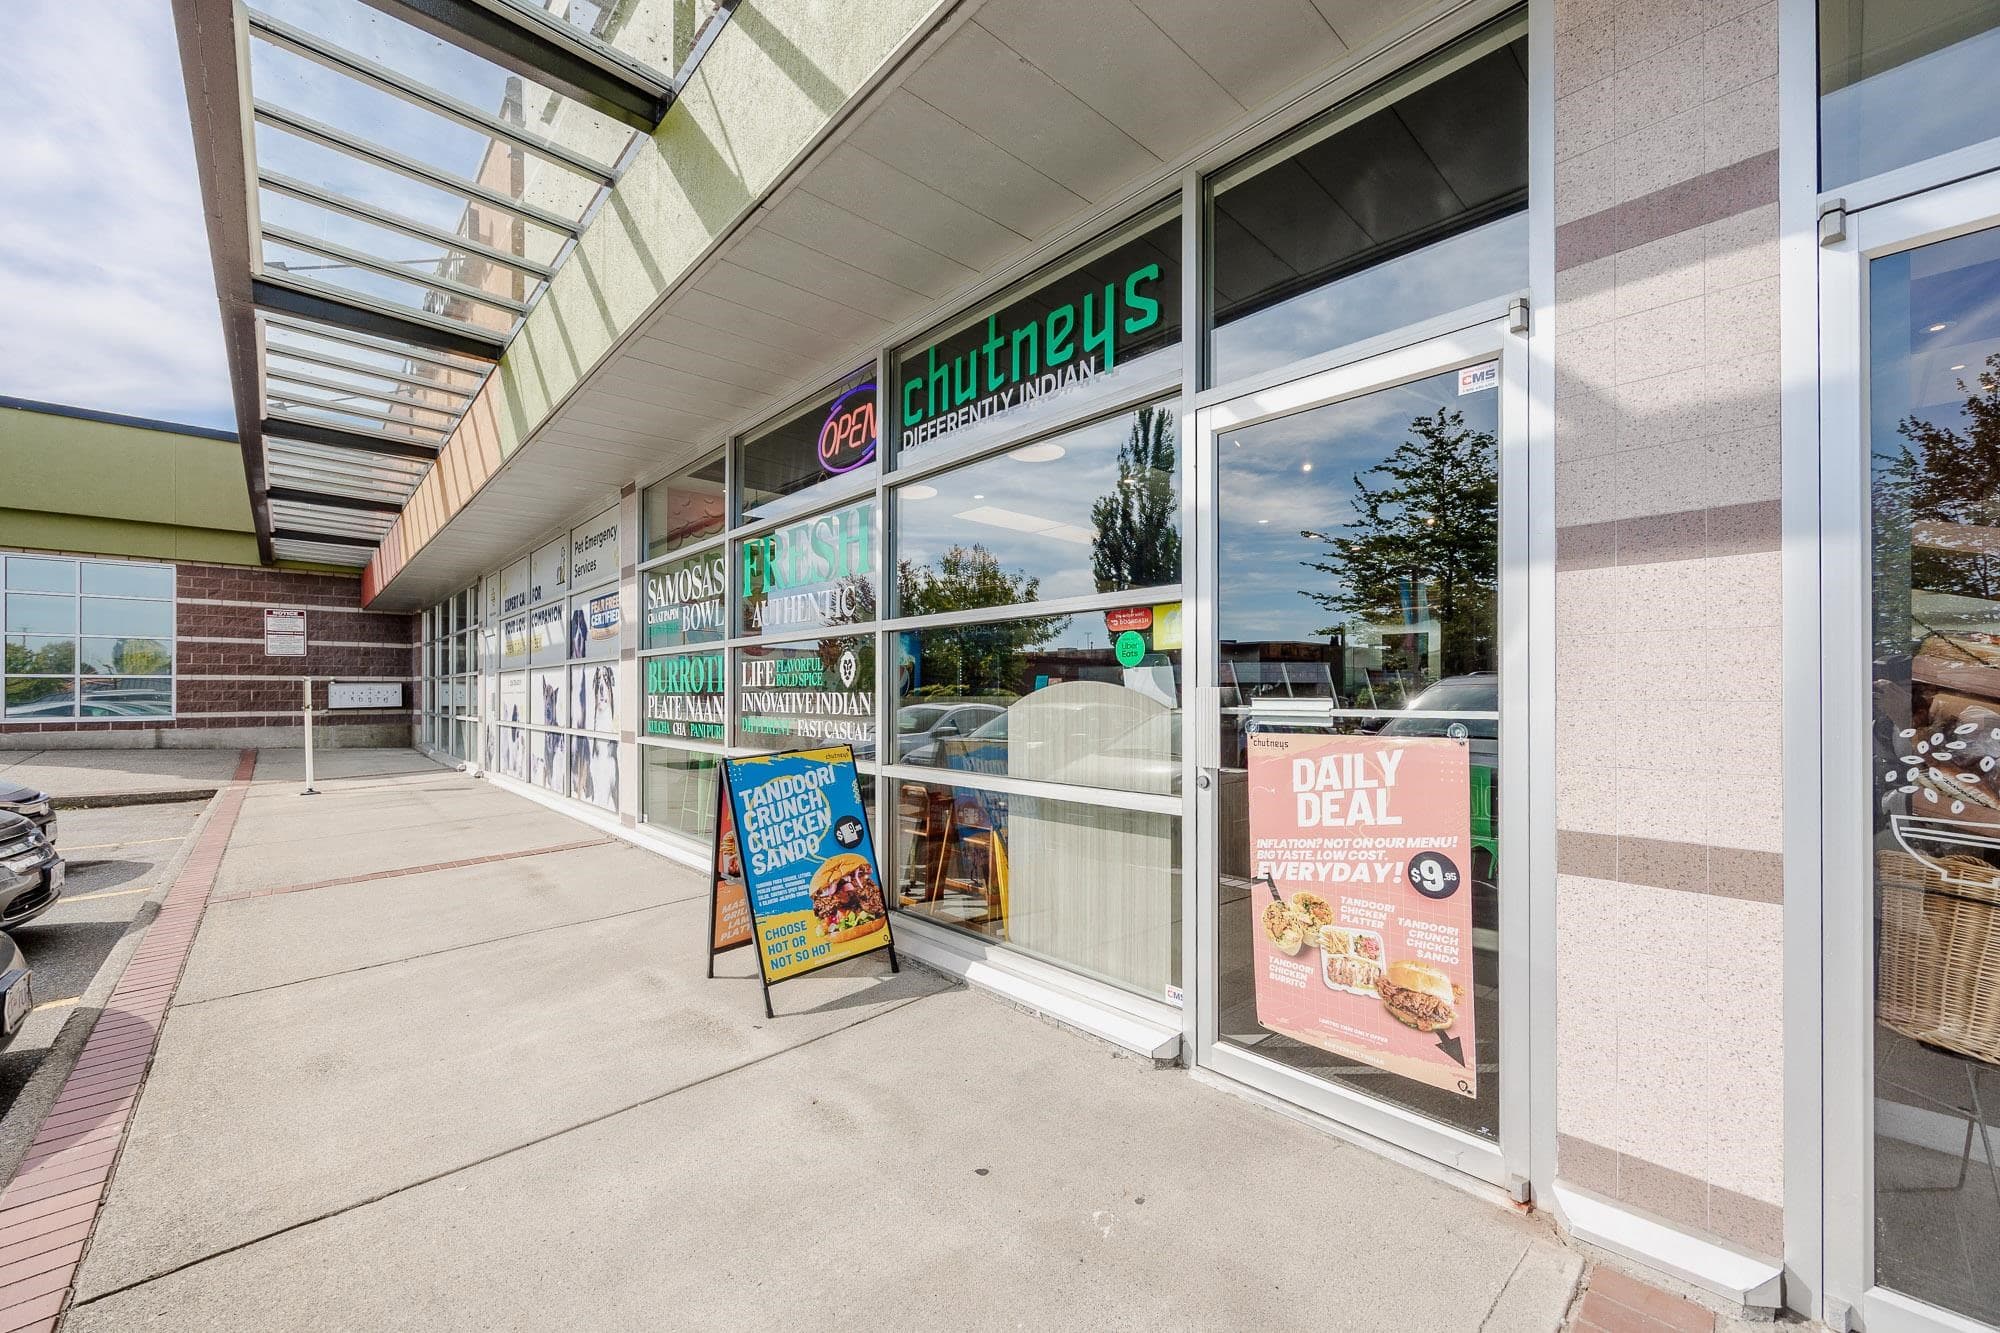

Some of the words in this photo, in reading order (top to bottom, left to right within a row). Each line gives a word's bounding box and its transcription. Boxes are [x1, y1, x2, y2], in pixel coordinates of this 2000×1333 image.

[903, 263, 1159, 427] chutneys
[1463, 369, 1495, 385] CMS
[903, 388, 1013, 450] DIFFERENTLY
[1020, 356, 1095, 408] INDIAN
[822, 403, 877, 458] OPEN
[574, 541, 584, 555] Pet
[585, 525, 618, 550] Emergency
[743, 504, 872, 598] FRESH
[574, 559, 597, 578] Services
[648, 558, 725, 610] SAMOSAS
[752, 586, 856, 628] AUTHENTIC
[1121, 642, 1138, 650] Uber
[1121, 650, 1138, 658] Eats
[741, 660, 776, 687] LIFE
[776, 657, 824, 672] FLAVORFUL
[776, 673, 798, 687] BOLD
[799, 672, 823, 687] SPICE
[648, 695, 683, 720] PLATE
[685, 695, 724, 723] NAAN
[741, 691, 814, 714] INNOVATIVE
[816, 692, 872, 716] INDIAN
[741, 716, 790, 736] DIFFERENT
[797, 720, 823, 738] FAST
[824, 720, 872, 741] CASUAL
[1253, 738, 1289, 750] chutneys
[1292, 749, 1404, 792] DAILY
[738, 764, 836, 811] TANDOORI
[743, 789, 824, 832] CRUNCH
[1297, 788, 1403, 828] DEAL
[748, 807, 832, 853] CHICKEN
[1256, 838, 1323, 849] INFLATION?
[1324, 838, 1351, 848] NOT
[1352, 838, 1374, 848] ON
[1375, 837, 1405, 848] OUR
[1406, 836, 1458, 848] MENU!
[751, 833, 820, 876] SANDO
[1316, 850, 1346, 860] LOW
[1347, 850, 1388, 860] COST.
[1256, 861, 1404, 883] EVERYDAY!
[1410, 859, 1457, 892] $9.95
[1340, 896, 1395, 912] TANDOORI
[1340, 905, 1387, 921] CHICKEN
[765, 920, 808, 940] CHOOSE
[1340, 914, 1385, 929] PLATTER
[1398, 917, 1459, 935] TANDOORI
[768, 940, 789, 955] HOT
[792, 935, 806, 948] OR
[1406, 938, 1459, 956] CHICKEN
[1409, 929, 1459, 946] CRUNCH
[770, 954, 792, 970] NOT
[795, 949, 810, 962] SO
[812, 942, 832, 957] HOT
[1268, 956, 1314, 975] TANDOORI
[1416, 948, 1459, 965] SANDO
[1269, 964, 1308, 981] CHICKEN
